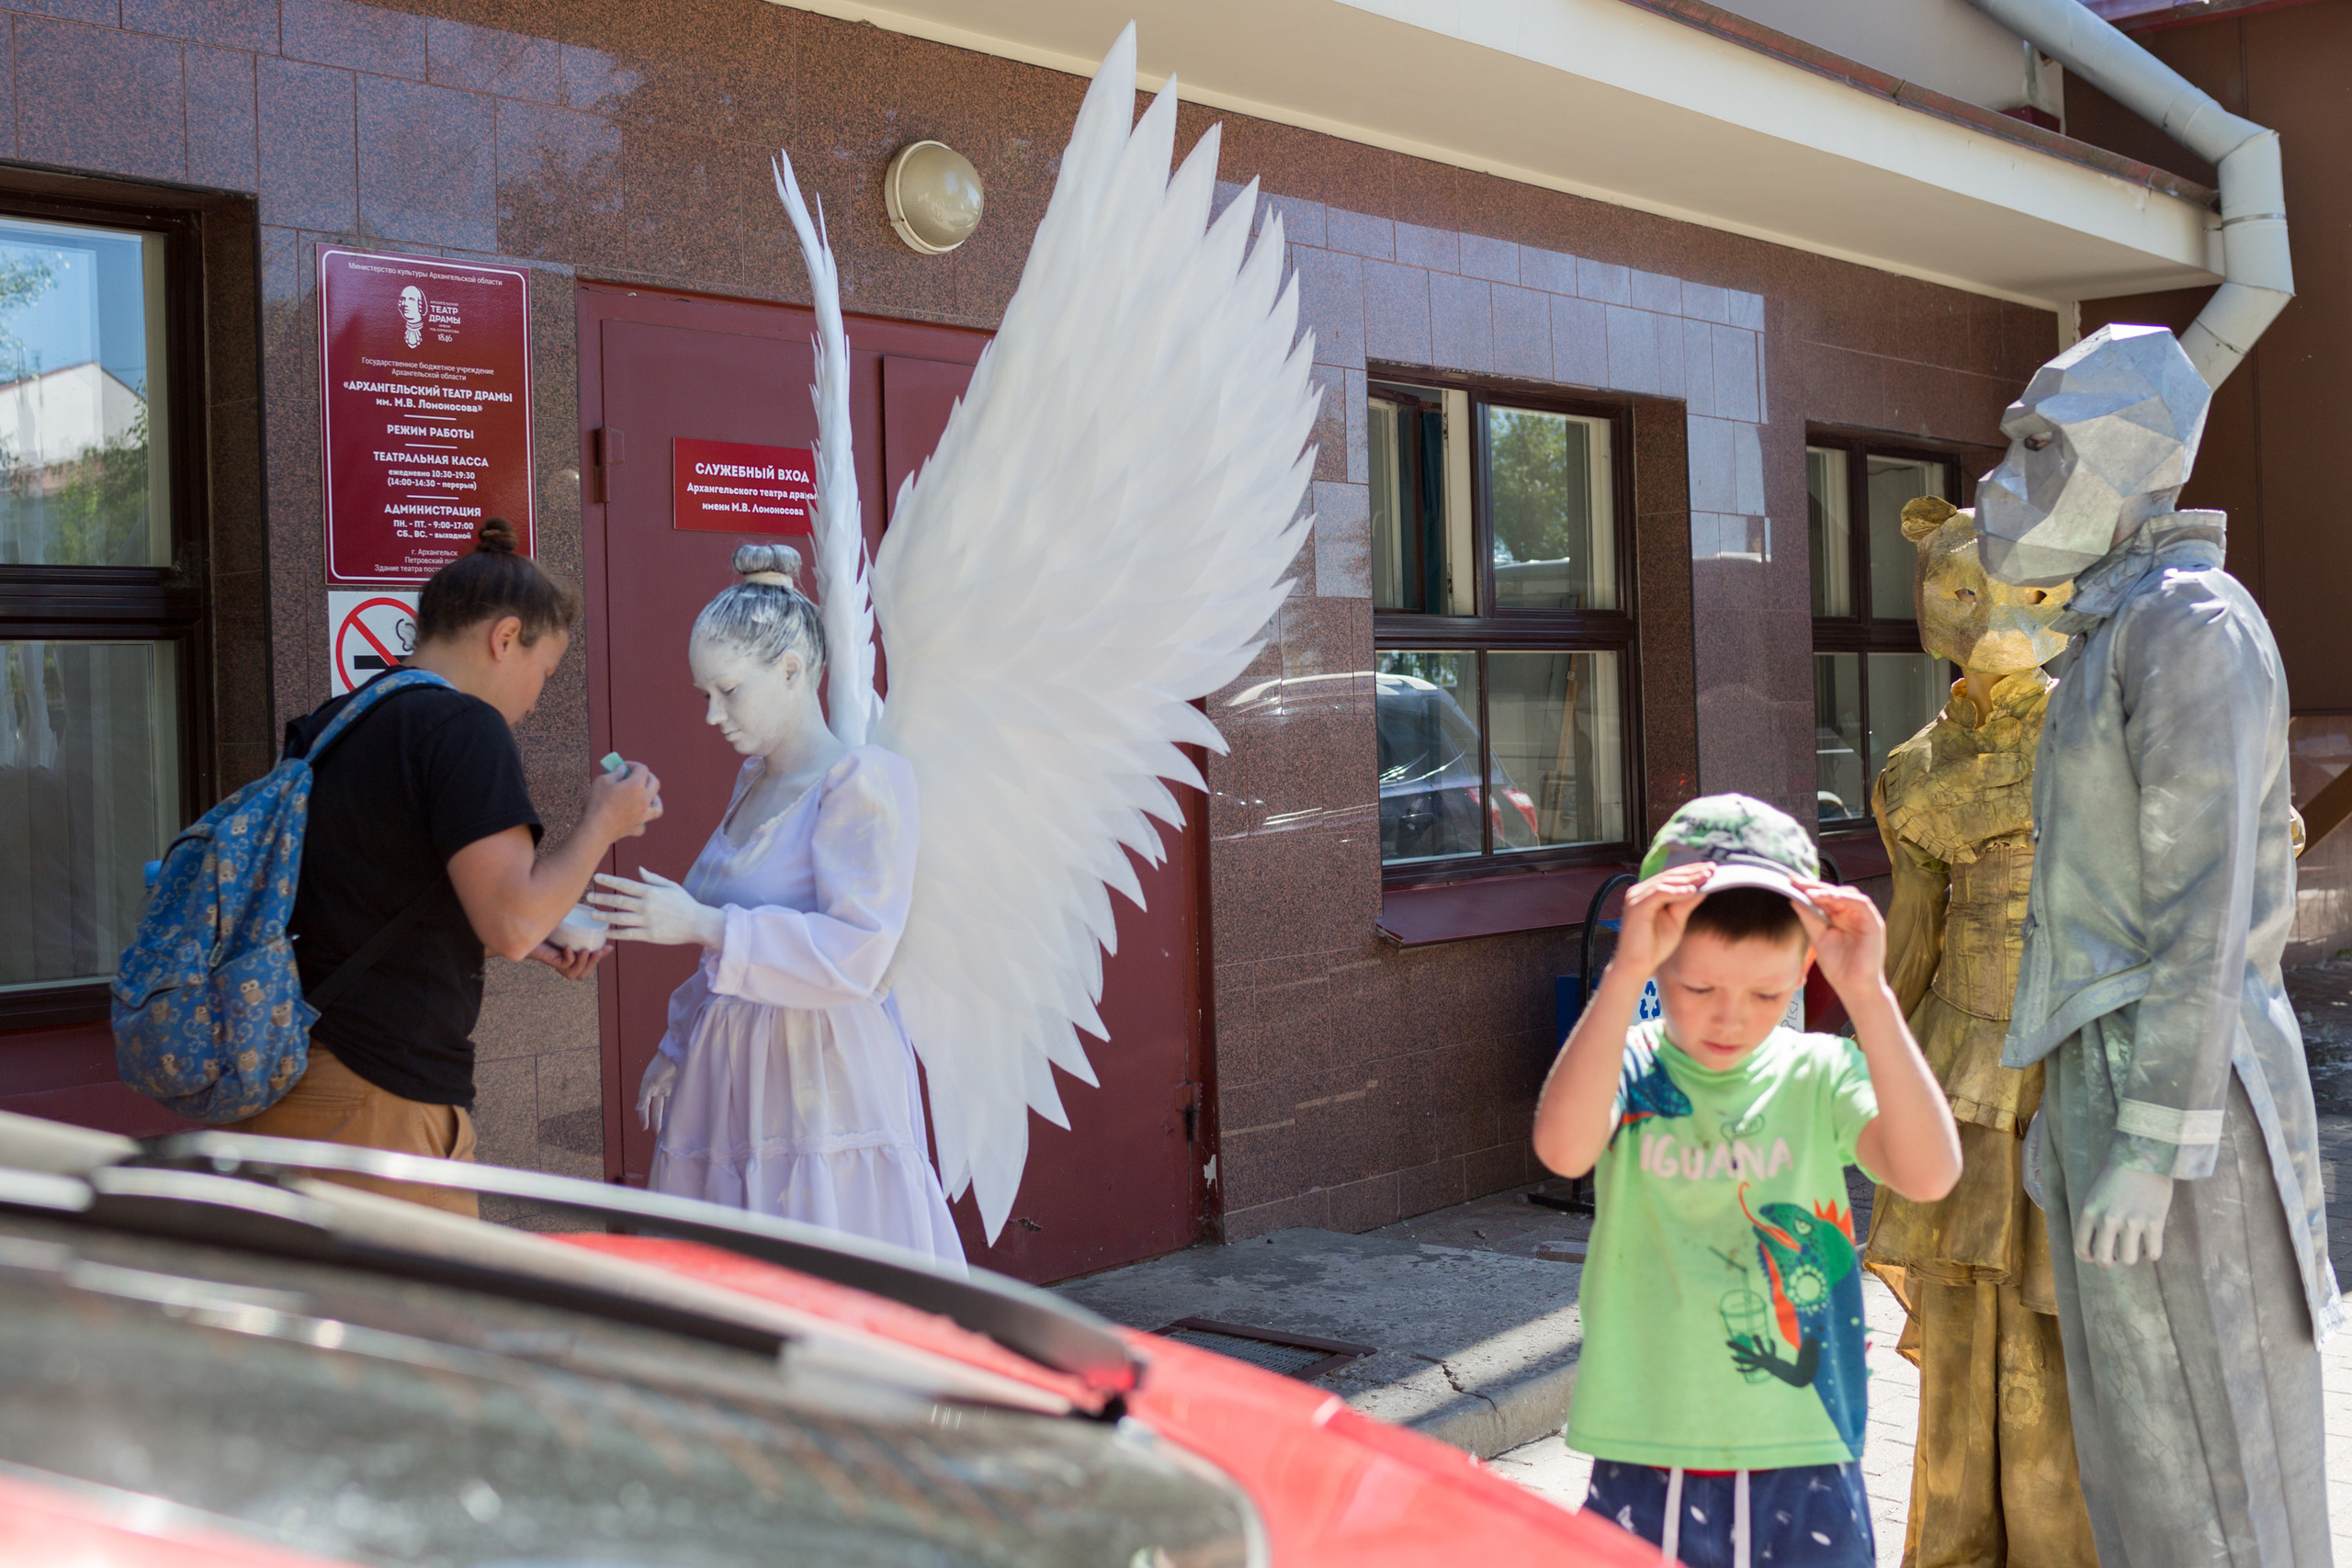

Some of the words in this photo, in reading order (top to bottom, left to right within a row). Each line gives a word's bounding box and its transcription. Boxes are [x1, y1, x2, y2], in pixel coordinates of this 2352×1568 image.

[349, 262, 396, 274] Министерство
[397, 269, 428, 278] культуры
[429, 272, 476, 284] Архангельской
[477, 276, 502, 286] области
[431, 305, 458, 315] ТЕАТР
[429, 314, 461, 324] ДРАМЫ
[438, 333, 452, 342] 1846
[362, 357, 418, 369] Государственное
[419, 362, 455, 372] бюджетное
[456, 366, 494, 376] учреждение
[392, 369, 439, 379] Архангельской
[441, 372, 466, 381] области
[343, 380, 441, 397] «АРХАНГЕЛЬСКИЙ
[443, 388, 472, 400] ТЕАТР
[474, 391, 512, 402] ДРАМЫ
[376, 398, 392, 406] им.
[394, 398, 416, 408] М.В.
[418, 400, 483, 413] Ломоносова»
[387, 424, 427, 436] РЕЖИМ
[430, 428, 474, 439] РАБОТЫ
[373, 451, 449, 465] ТЕАТРАЛЬНАЯ
[452, 456, 489, 467] КАССА
[432, 470, 475, 480] 10:30-19:30
[695, 462, 775, 480] СЛУЖЕБНЫЙ
[778, 468, 809, 483] ВХОД
[387, 478, 435, 488] (14:00-14:30
[442, 481, 477, 491] перерыв)
[687, 482, 758, 496] Архангельского
[760, 489, 788, 500] театра
[384, 504, 481, 518] АДМИНИСТРАЦИЯ
[732, 503, 750, 513] М.В.
[752, 504, 804, 516] Ломоносова
[394, 520, 407, 528] ПН.
[434, 521, 474, 530] 9:00-17:00
[397, 530, 413, 539] СБ.,
[435, 531, 471, 540] выходной
[405, 556, 443, 565] Петровский
[1640, 1133, 1794, 1181] IGUANA
